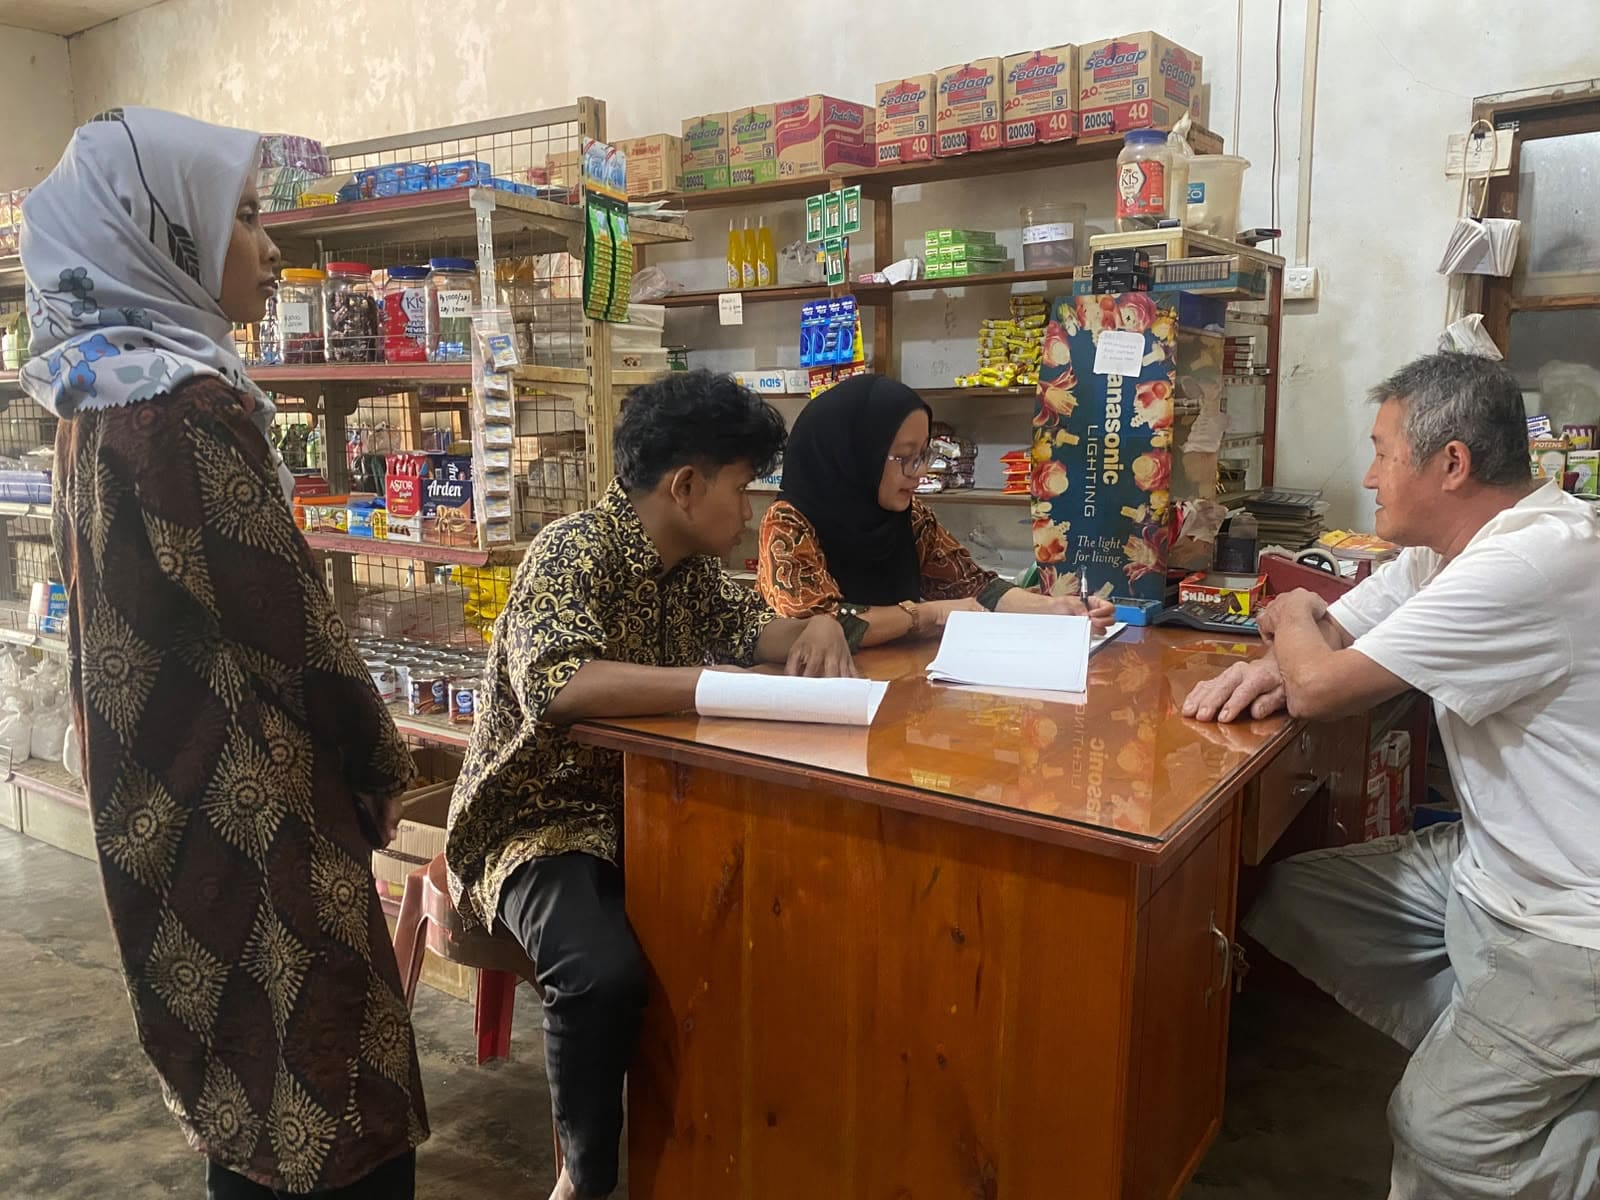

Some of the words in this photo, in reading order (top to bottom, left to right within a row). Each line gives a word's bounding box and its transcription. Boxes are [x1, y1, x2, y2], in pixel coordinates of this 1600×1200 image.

[1084, 49, 1147, 71] Sedaap
[1007, 62, 1066, 83] Sedaap
[1159, 58, 1197, 89] Sedaap
[940, 75, 994, 94] Sedaap
[1137, 84, 1145, 95] 9
[879, 89, 927, 107] Sedaap
[1056, 95, 1064, 106] 9
[1084, 111, 1113, 130] 20030
[1128, 103, 1148, 121] 40
[684, 126, 725, 142] Sedaap
[731, 119, 773, 135] Sedaap
[1008, 122, 1035, 140] 20030
[1049, 113, 1067, 131] 40
[912, 137, 928, 152] 40
[941, 133, 967, 150] 20030
[980, 125, 997, 141] 40
[761, 163, 773, 175] 40
[1102, 374, 1124, 485] anasonic
[1084, 425, 1099, 517] LIGHTING
[389, 479, 414, 492] ASTOR
[427, 480, 463, 498] Arden
[1077, 535, 1096, 548] The
[1098, 536, 1121, 553] light
[1072, 549, 1091, 565] for
[1091, 550, 1123, 568] living.
[1181, 590, 1222, 604] SNAPS
